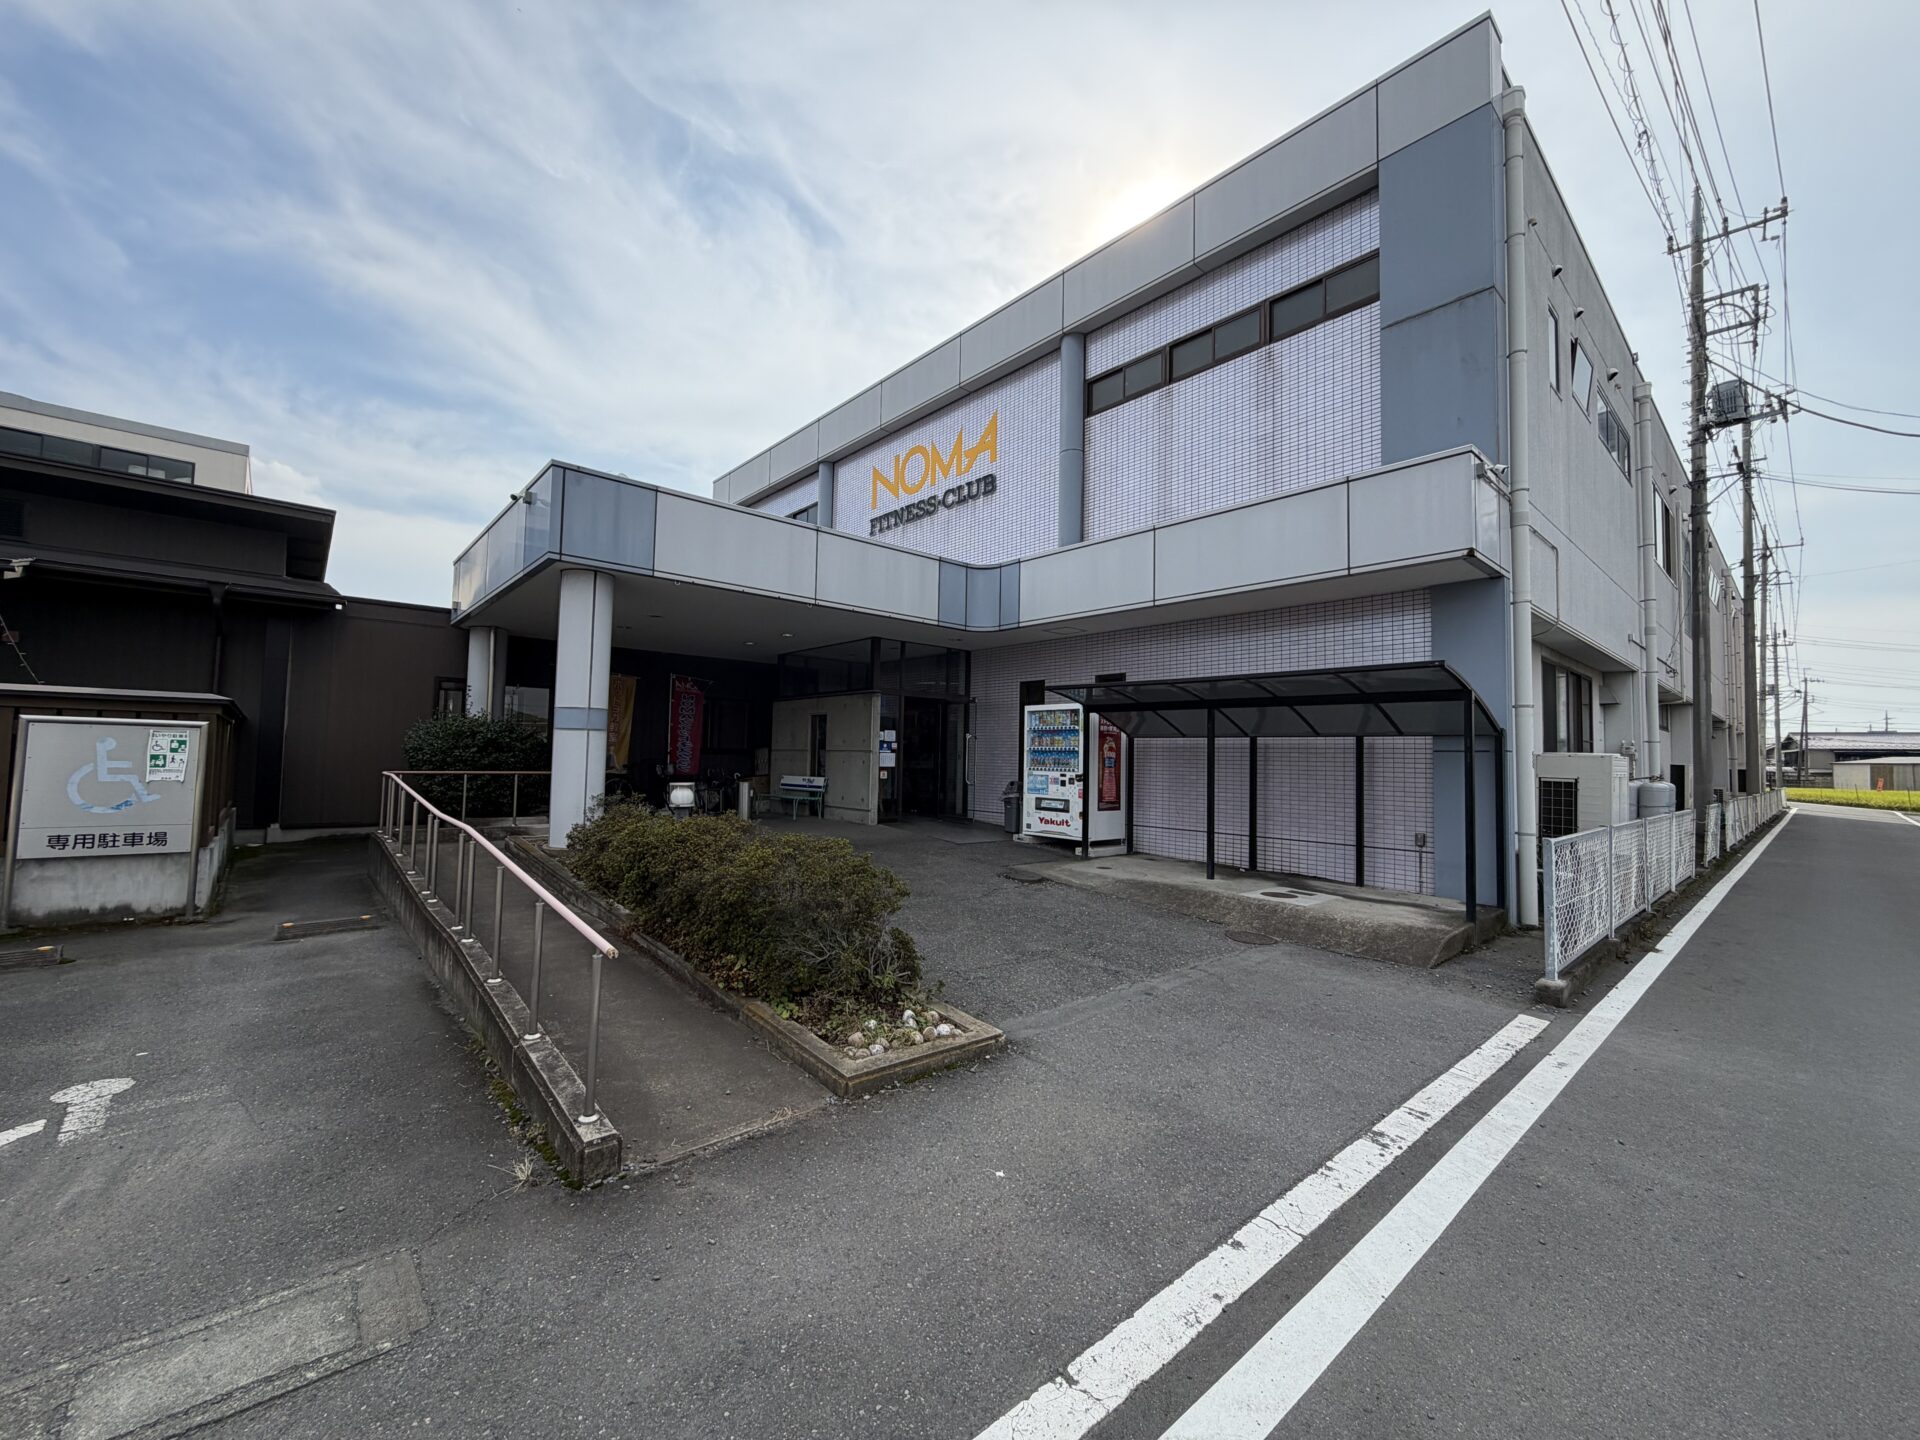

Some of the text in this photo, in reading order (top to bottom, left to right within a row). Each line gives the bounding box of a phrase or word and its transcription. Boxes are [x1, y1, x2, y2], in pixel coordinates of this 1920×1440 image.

[870, 408, 999, 511] NOMA
[1038, 816, 1072, 827] Yakult
[46, 831, 168, 851] 専用駐車場
